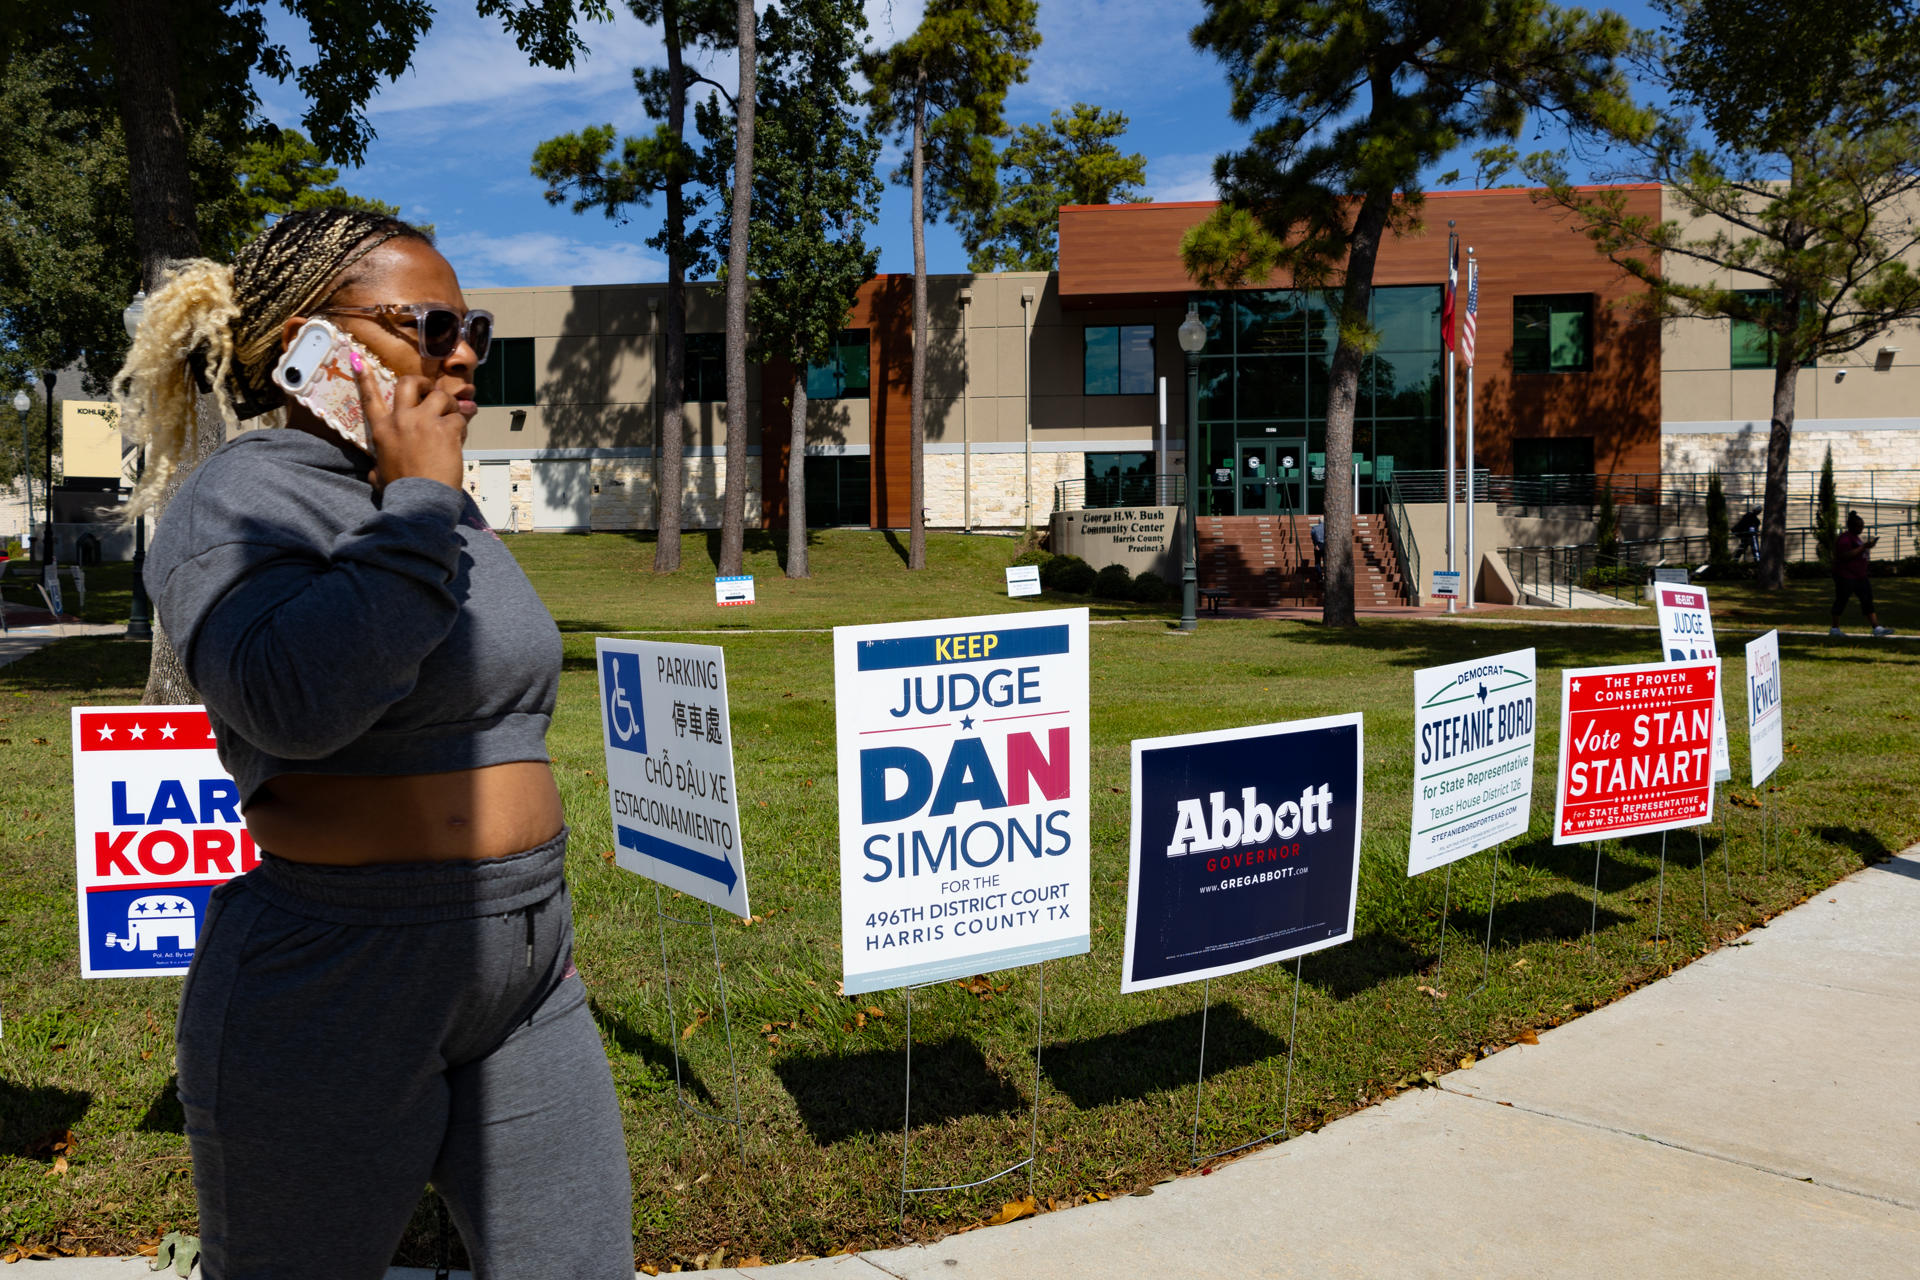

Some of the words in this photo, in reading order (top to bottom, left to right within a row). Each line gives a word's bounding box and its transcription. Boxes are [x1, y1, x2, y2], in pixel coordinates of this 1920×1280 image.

[1081, 523, 1128, 536] Community
[1130, 522, 1165, 533] Center
[1083, 512, 1112, 524] George
[1113, 510, 1137, 522] H.W.
[1139, 510, 1164, 520] Bush
[1112, 535, 1135, 544] Harris
[1137, 534, 1164, 543] County
[1128, 544, 1158, 553] Precinct
[1159, 544, 1165, 553] 3
[1673, 612, 1705, 635] JUDGE
[935, 633, 999, 662] KEEP
[657, 655, 718, 690] PARKING
[889, 665, 1042, 718] JUDGE
[1457, 665, 1504, 685] DEMOCRAT
[1750, 659, 1780, 727] Jewell
[671, 699, 723, 745] 停車處
[1421, 706, 1495, 765] STEFANIE
[1497, 696, 1533, 743] BORD
[1632, 708, 1710, 748] STAN
[644, 748, 673, 789] CHỖ
[676, 759, 706, 801] ĐẬU
[709, 771, 729, 805] XE
[859, 726, 1071, 826] DAN
[1423, 785, 1438, 800] for
[1440, 778, 1465, 796] State
[1466, 755, 1529, 787] Representative
[1569, 748, 1708, 797] STANART
[614, 789, 733, 851] ESTACIONAMIENTO
[1166, 782, 1333, 858] Abbott
[1430, 806, 1454, 821] Texas
[1456, 795, 1481, 813] House
[1482, 785, 1509, 803] District
[1510, 778, 1521, 792] 126
[1572, 810, 1586, 820] for
[862, 809, 1072, 883] SIMONS
[1431, 805, 1518, 844] STEFANIEBORDFORTEXAS.COM
[1206, 842, 1301, 873] GOVERNOR
[865, 906, 924, 928] 496TH
[929, 893, 1008, 919] DISTRICT
[1010, 883, 1070, 906] COURT
[941, 879, 970, 895] FOR
[973, 874, 1000, 890] THE
[866, 925, 944, 951] HARRIS
[953, 908, 1040, 937] COUNTY
[1046, 904, 1071, 921] TX
